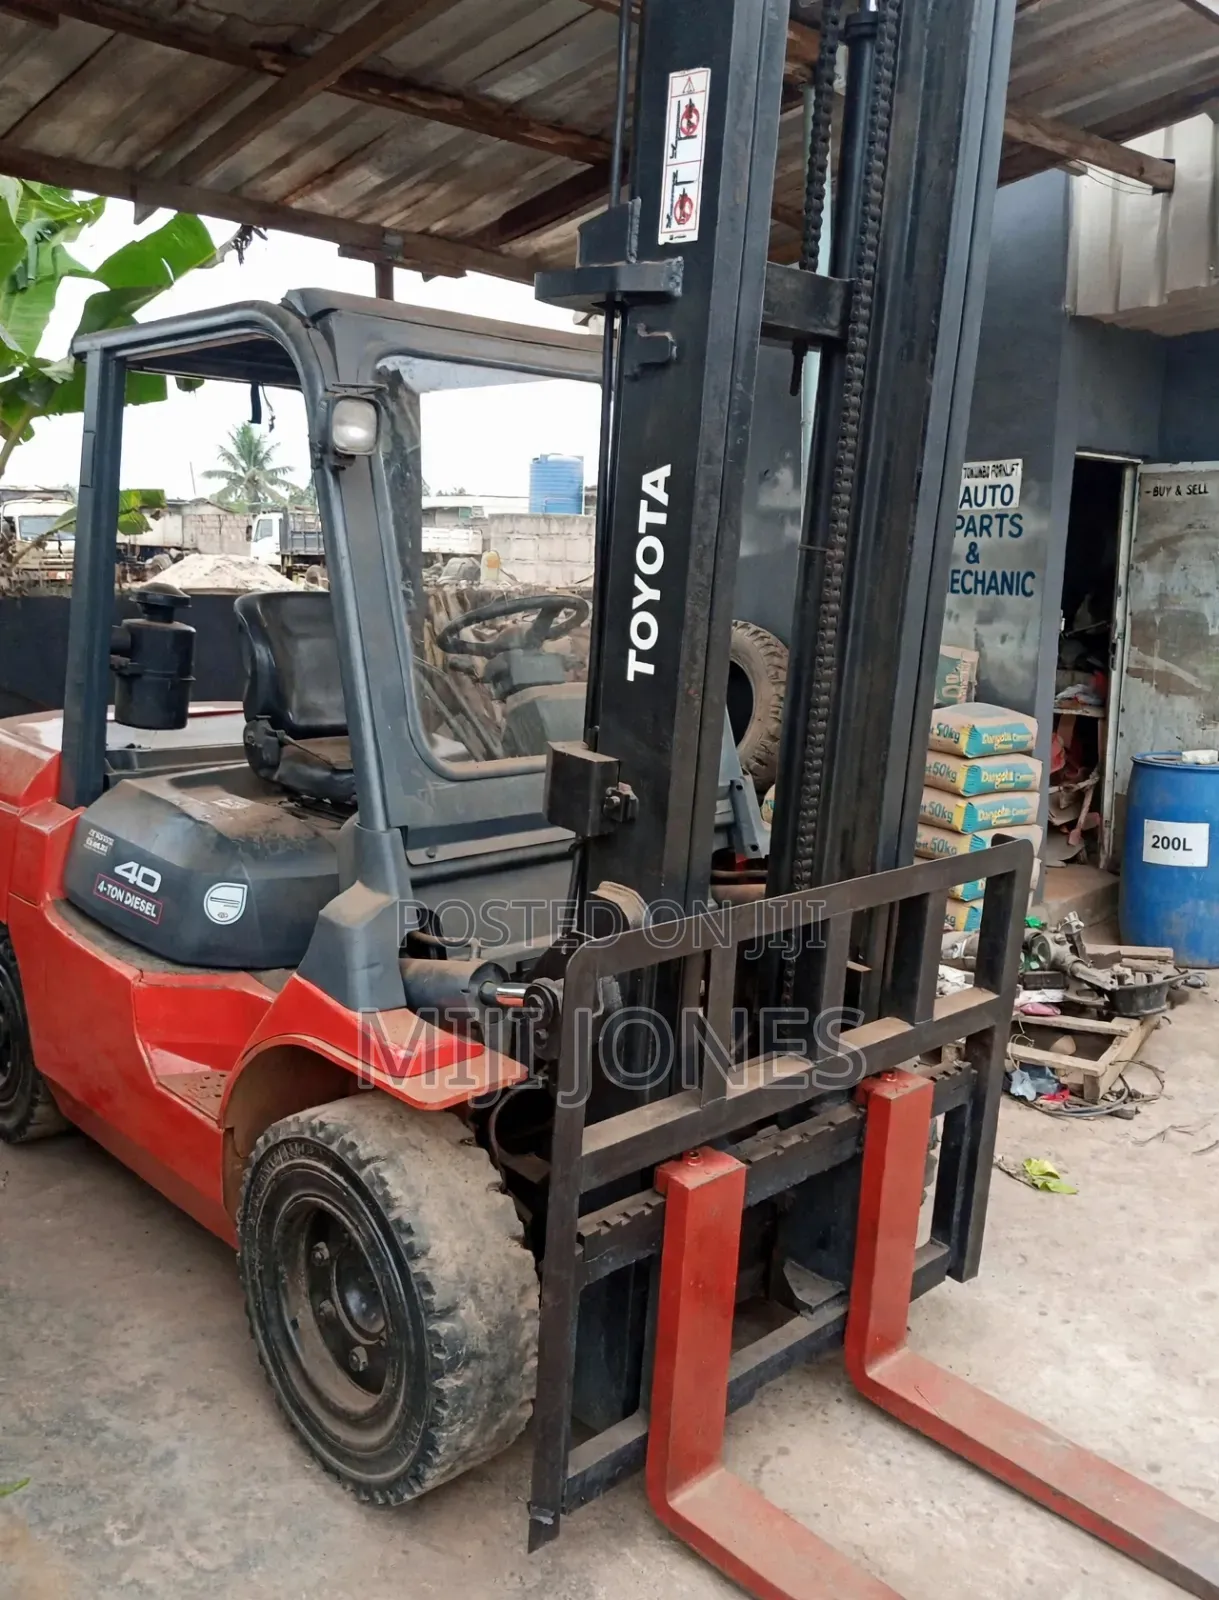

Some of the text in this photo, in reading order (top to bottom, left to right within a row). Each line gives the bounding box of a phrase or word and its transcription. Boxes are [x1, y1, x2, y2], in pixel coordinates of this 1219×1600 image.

[959, 483, 1015, 509] AUTO
[1175, 485, 1182, 496] &
[1186, 484, 1209, 495] SELL
[954, 513, 1024, 538] PARTS
[966, 541, 980, 564] &
[626, 463, 672, 682] TOYOTA
[950, 569, 1036, 597] ECHANIC
[936, 722, 961, 744] 50kg
[932, 761, 958, 784] 50kg
[928, 801, 954, 825] 50kg
[931, 836, 958, 855] 50kg
[1151, 834, 1194, 852] 200L
[114, 861, 162, 893] 40
[97, 880, 157, 918] 4-TON DIESEL
